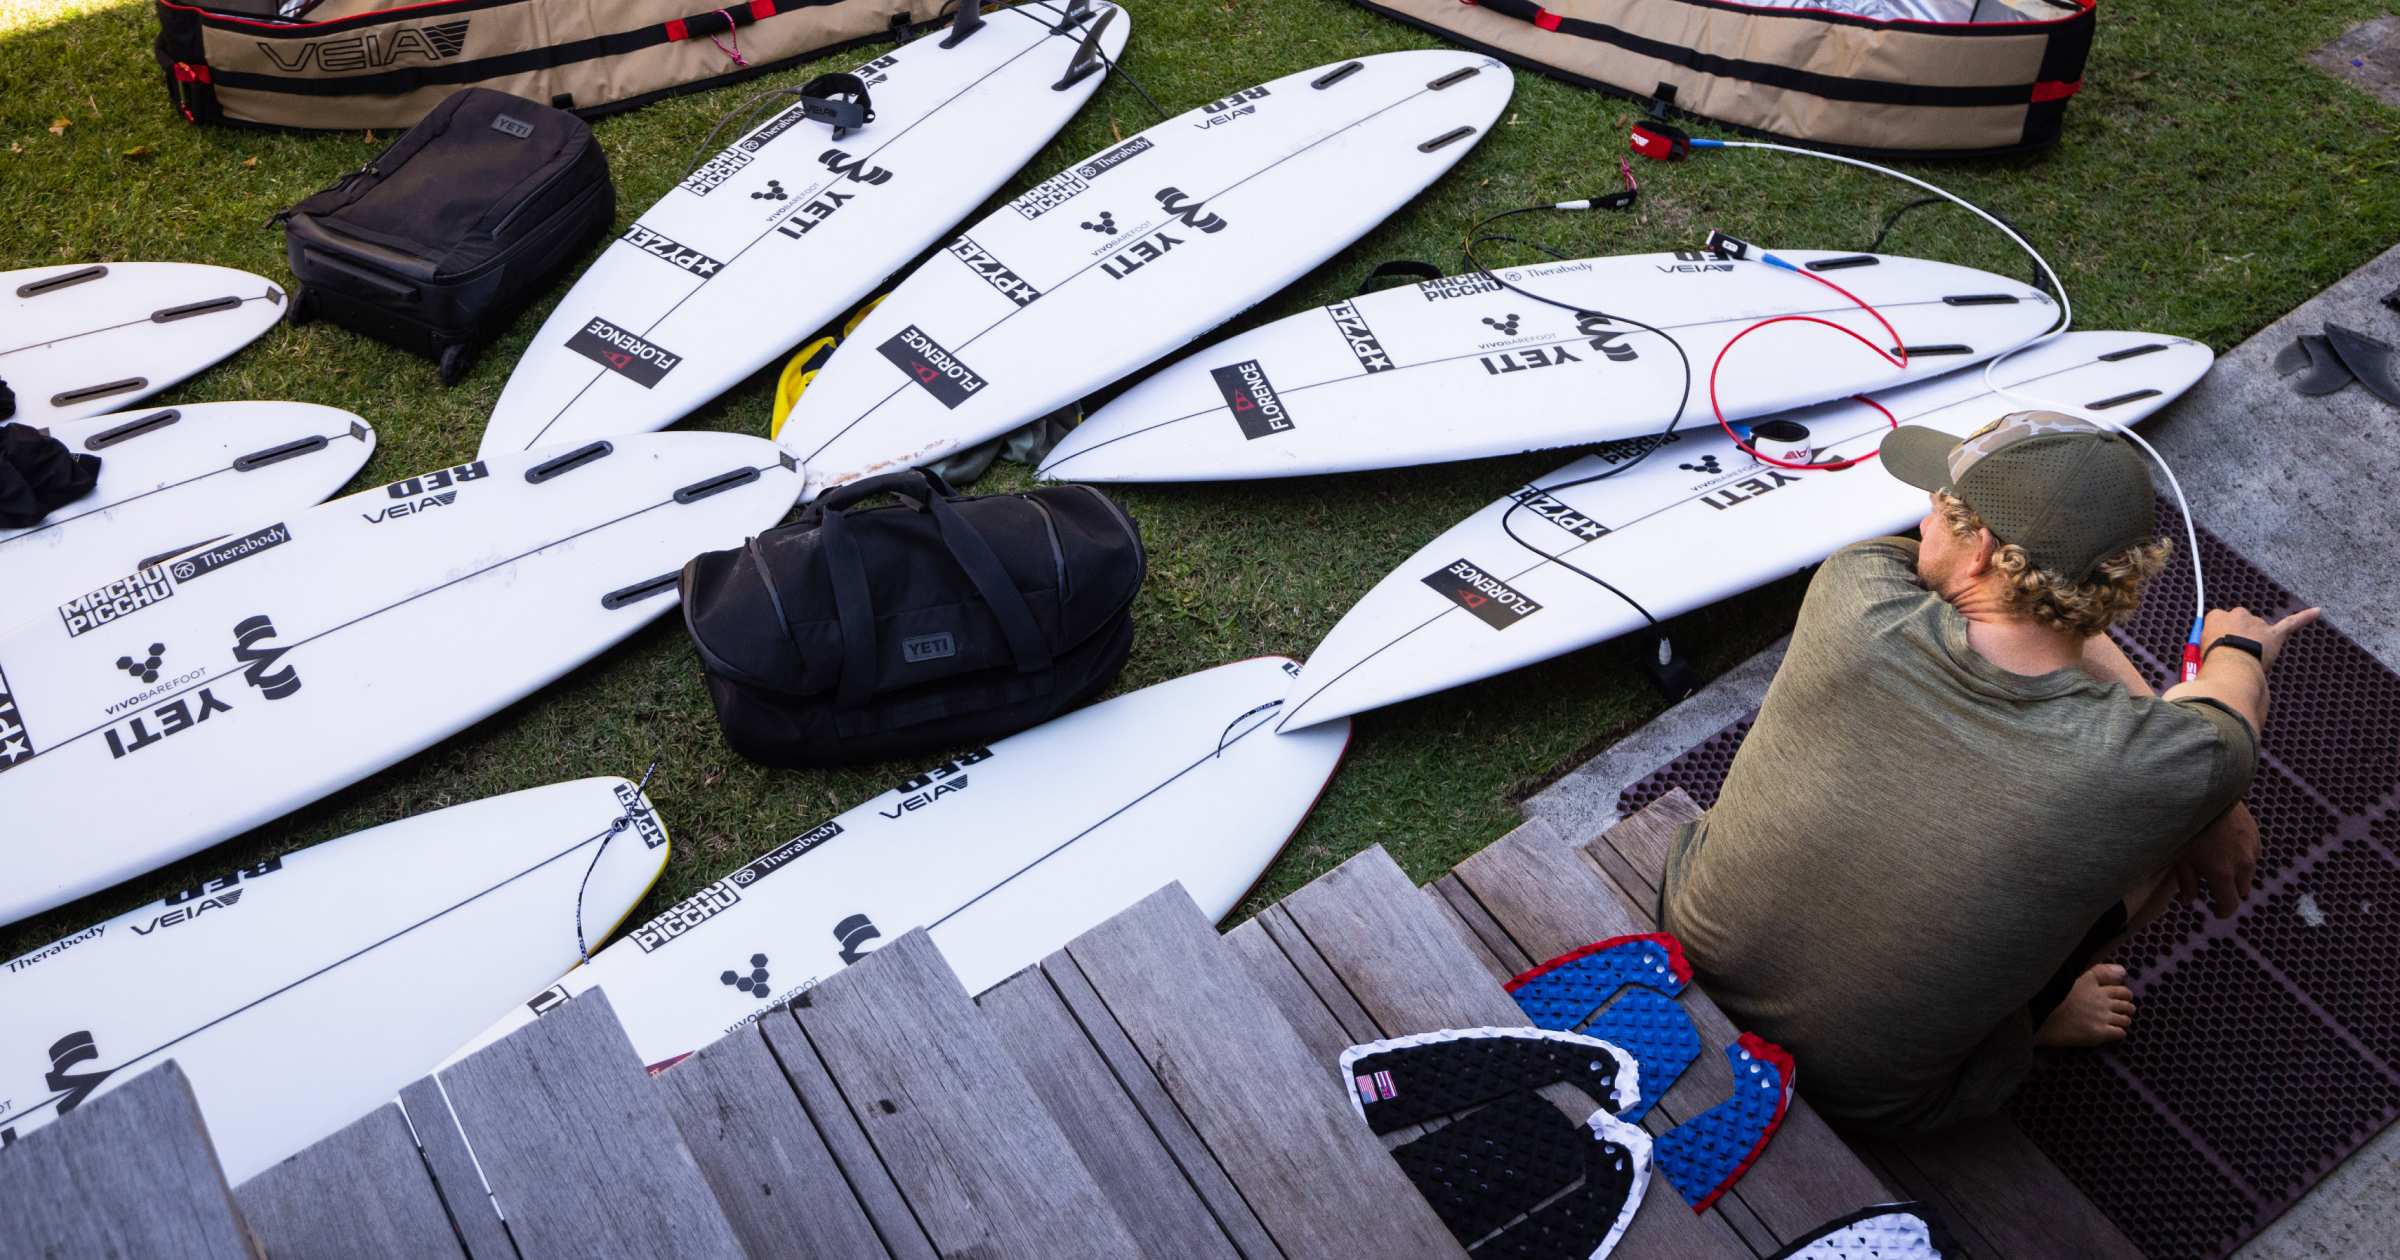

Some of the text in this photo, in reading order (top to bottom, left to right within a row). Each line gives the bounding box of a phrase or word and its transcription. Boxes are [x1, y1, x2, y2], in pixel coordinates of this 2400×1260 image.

[257, 29, 440, 73] VEIA
[855, 55, 899, 78] RE
[1194, 107, 1251, 130] VEIA
[1203, 86, 1272, 114] RED
[497, 118, 530, 138] YETI
[756, 107, 805, 142] Therabody
[683, 147, 739, 191] MACHU
[692, 150, 753, 196] PICCHU
[1095, 138, 1151, 170] Therabody
[1011, 170, 1075, 210] MACHU
[1021, 179, 1088, 220] PICCHU
[777, 191, 855, 240] YETI
[622, 224, 703, 269] PYZEL
[950, 236, 1023, 294] PYZEL
[1100, 232, 1186, 280] YETI
[1527, 262, 1593, 278] Therabody
[1656, 264, 1722, 273] VEIA
[1423, 281, 1504, 302] PICCHU
[587, 321, 676, 370] FLORENCE
[1328, 299, 1383, 358] PYZEL
[900, 329, 982, 392] FLORENCE
[1480, 346, 1583, 375] YETI
[1239, 362, 1289, 431] FLORENCE
[387, 460, 489, 498] RED
[1700, 471, 1803, 511] YETI
[362, 494, 443, 524] VEIA
[200, 526, 286, 568] Therabody
[60, 565, 163, 620] MACHU
[67, 580, 173, 636] PICCHU
[1448, 561, 1536, 616] FLORENCE
[908, 638, 949, 656] YETI
[105, 667, 207, 715] VIVOBAREFOOT
[104, 688, 233, 759] YETI
[879, 783, 958, 819] VEIA
[757, 823, 838, 870] Therabody
[130, 897, 225, 935] VEIA
[638, 887, 739, 951] PICCHU
[7, 925, 107, 973] Therabody
